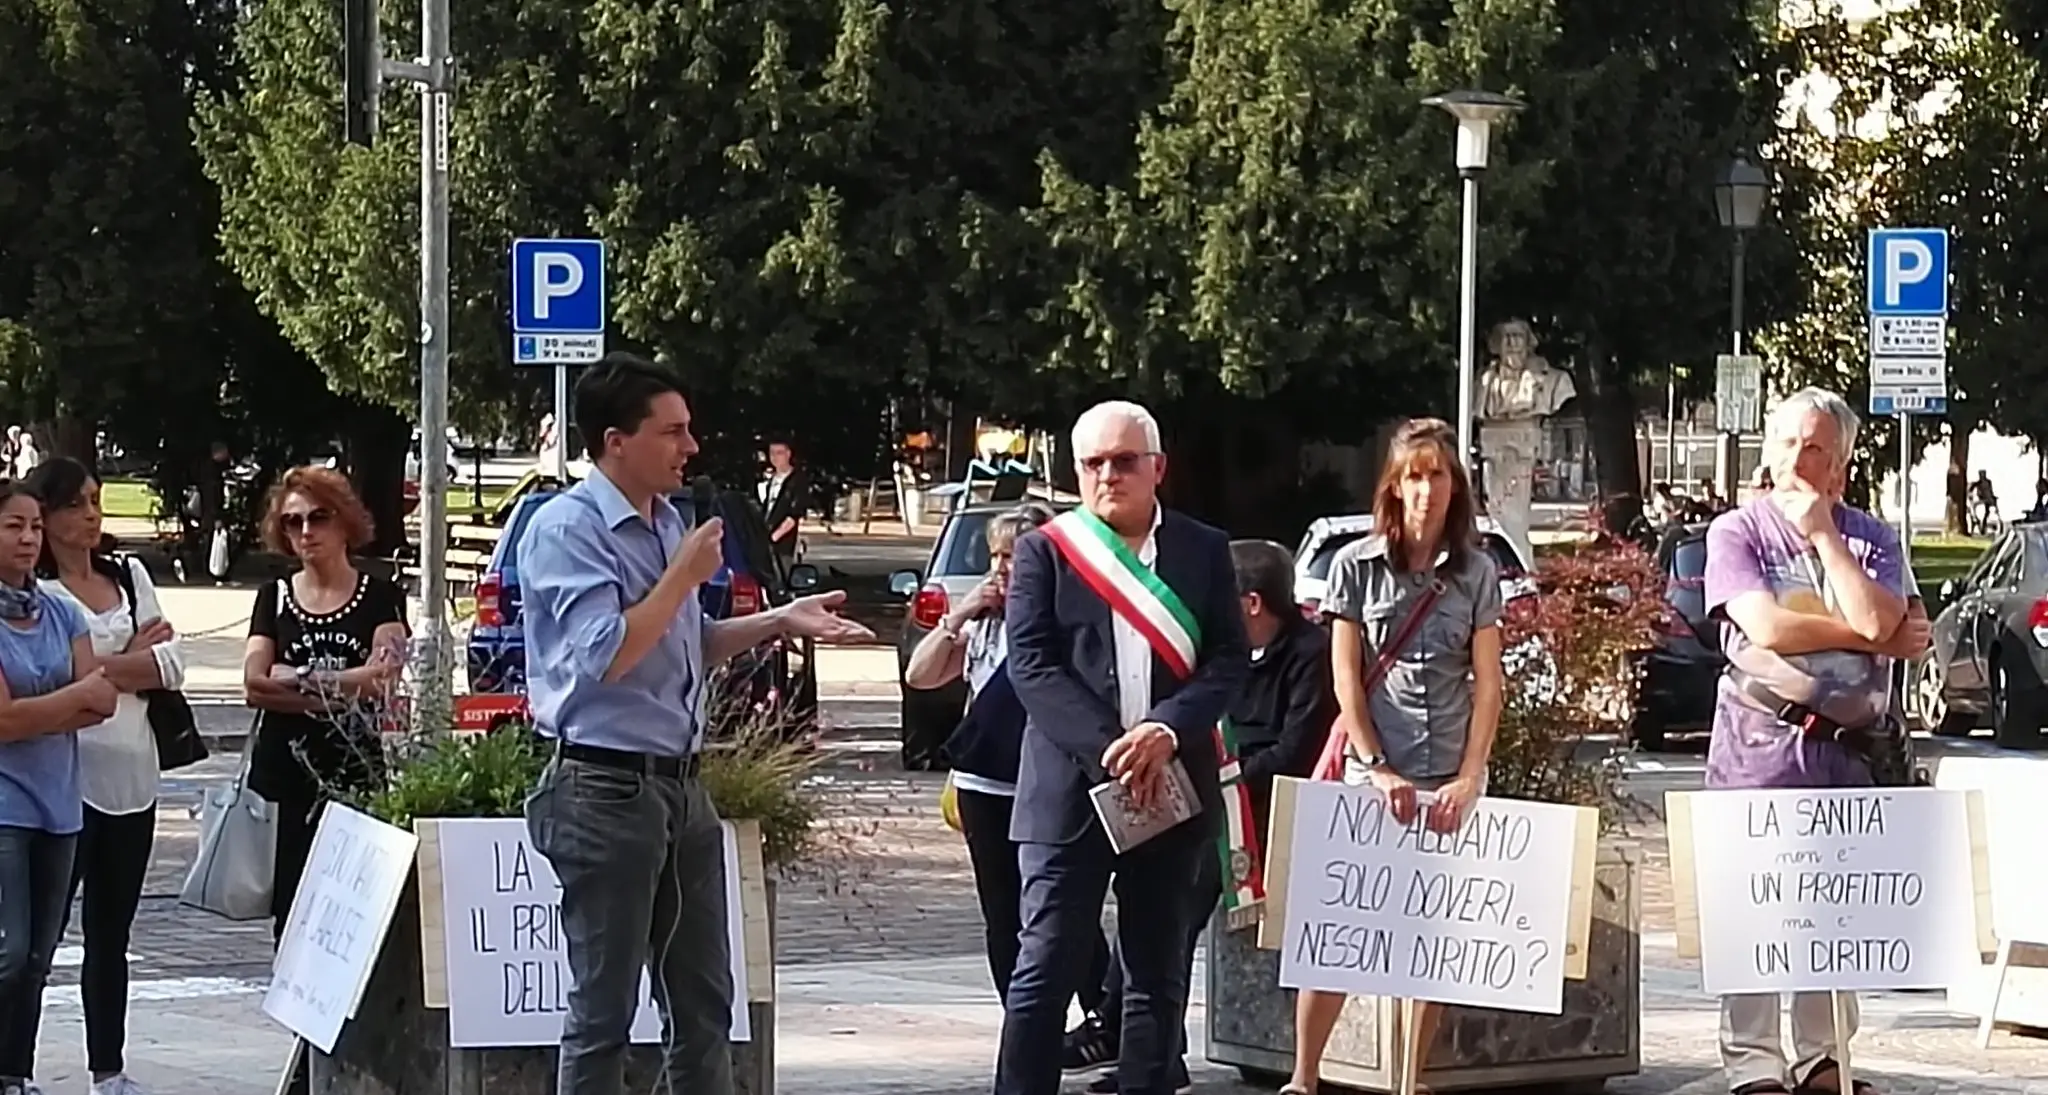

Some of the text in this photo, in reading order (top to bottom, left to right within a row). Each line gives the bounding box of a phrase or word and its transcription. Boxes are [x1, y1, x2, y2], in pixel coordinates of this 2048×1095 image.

[534, 252, 583, 319] P
[1885, 239, 1933, 306] P
[1328, 793, 1386, 847] NOI
[1749, 800, 1780, 838] LA
[494, 841, 533, 893] LA
[1775, 849, 1823, 864] non
[1320, 860, 1531, 931] SOLO DOVERI e
[1751, 872, 1922, 906] UN PROFITTO
[470, 907, 498, 952] IL
[1296, 922, 1393, 974] NESSUN
[1782, 918, 1816, 929] ma
[1756, 938, 1910, 976] UN DIRITTO
[504, 960, 568, 1015] DELL
